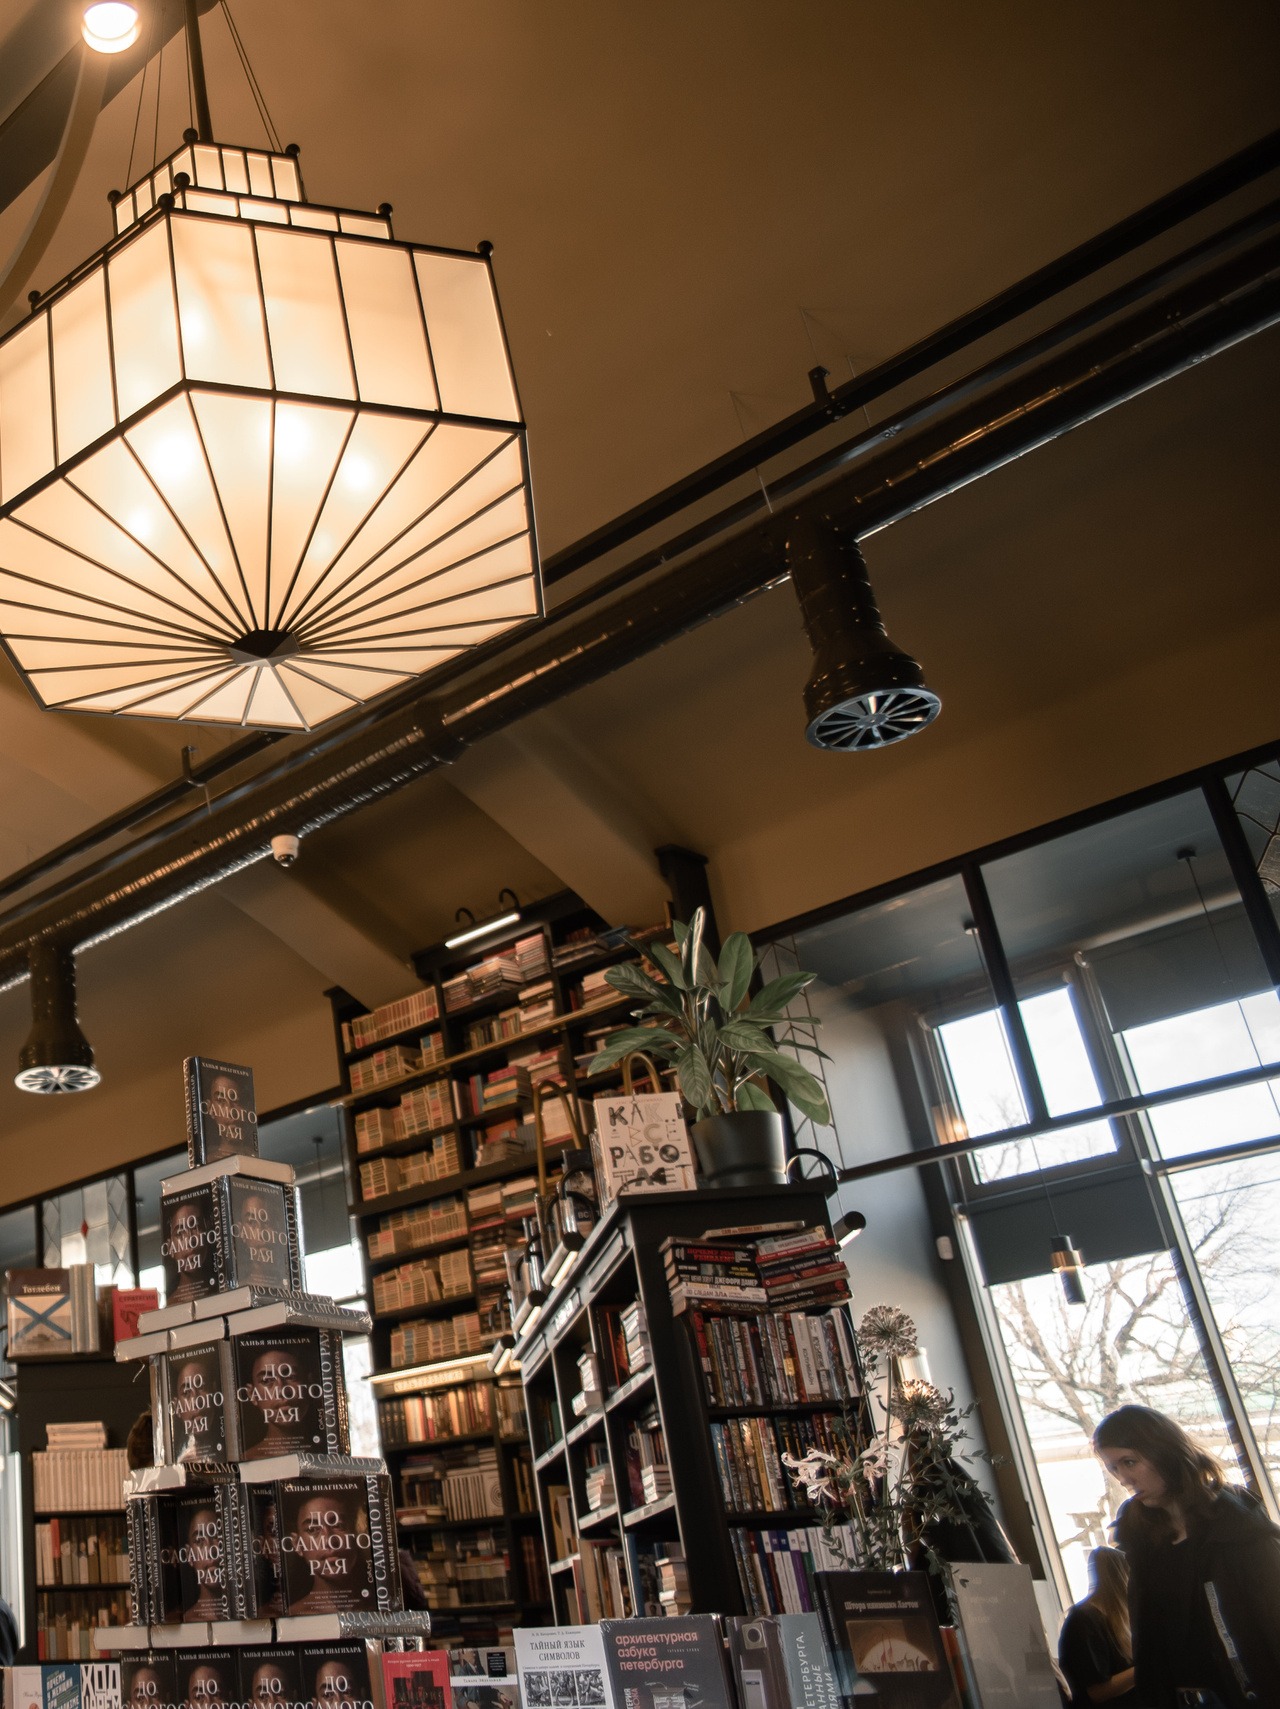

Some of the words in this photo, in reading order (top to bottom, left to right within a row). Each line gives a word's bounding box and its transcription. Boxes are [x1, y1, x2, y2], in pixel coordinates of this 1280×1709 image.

[218, 1086, 237, 1101] ДО
[199, 1101, 258, 1124] САМОГО
[218, 1123, 242, 1140] РАЯ
[248, 1207, 268, 1222] ДО
[177, 1215, 197, 1233] ДО
[161, 1230, 217, 1256] САМОГО
[230, 1224, 288, 1245] САМОГО
[177, 1254, 201, 1273] РАЯ
[249, 1247, 274, 1264] РАЯ
[22, 1285, 61, 1294] Тотлебен
[240, 1339, 265, 1347] ХАНЬЯ
[267, 1338, 310, 1346] ЯНАГИХАРА
[263, 1363, 292, 1380] ДО
[183, 1374, 202, 1392] ДО
[237, 1384, 322, 1402] САМОГО
[321, 1361, 336, 1428] САМОГО
[168, 1391, 224, 1415] САМОГО
[263, 1407, 300, 1424] РАЯ
[184, 1417, 208, 1434] РАЯ
[327, 1433, 338, 1455] ДО
[204, 1463, 240, 1474] САМО
[317, 1454, 365, 1467] САМОГО
[284, 1484, 310, 1492] ХАНЬЯ
[312, 1483, 358, 1491] ЯНАГИХАРА
[366, 1474, 379, 1503] РАЯ
[308, 1510, 340, 1530] ДО
[196, 1522, 217, 1540] ДО
[281, 1533, 371, 1553] САМОГО
[369, 1508, 387, 1581] САМОГО
[179, 1545, 220, 1564] САМО
[308, 1558, 348, 1576] РАЯ
[197, 1568, 221, 1585] РАЯ
[377, 1586, 391, 1612] ДО
[358, 1610, 408, 1624] САМОГО
[530, 1640, 562, 1650] ТАЙНЫЙ
[564, 1640, 586, 1649] ЯЗЫК
[615, 1632, 698, 1646] архитектурная
[538, 1651, 580, 1662] СИМВОЛОВ
[618, 1646, 657, 1659] азбука
[619, 1658, 684, 1673] петербурга
[796, 1631, 816, 1709] ЕТЕРБУРГА.
[137, 1681, 157, 1698] ДО
[195, 1679, 218, 1697] ДО
[260, 1677, 281, 1696] ДО
[325, 1675, 348, 1694] ДО
